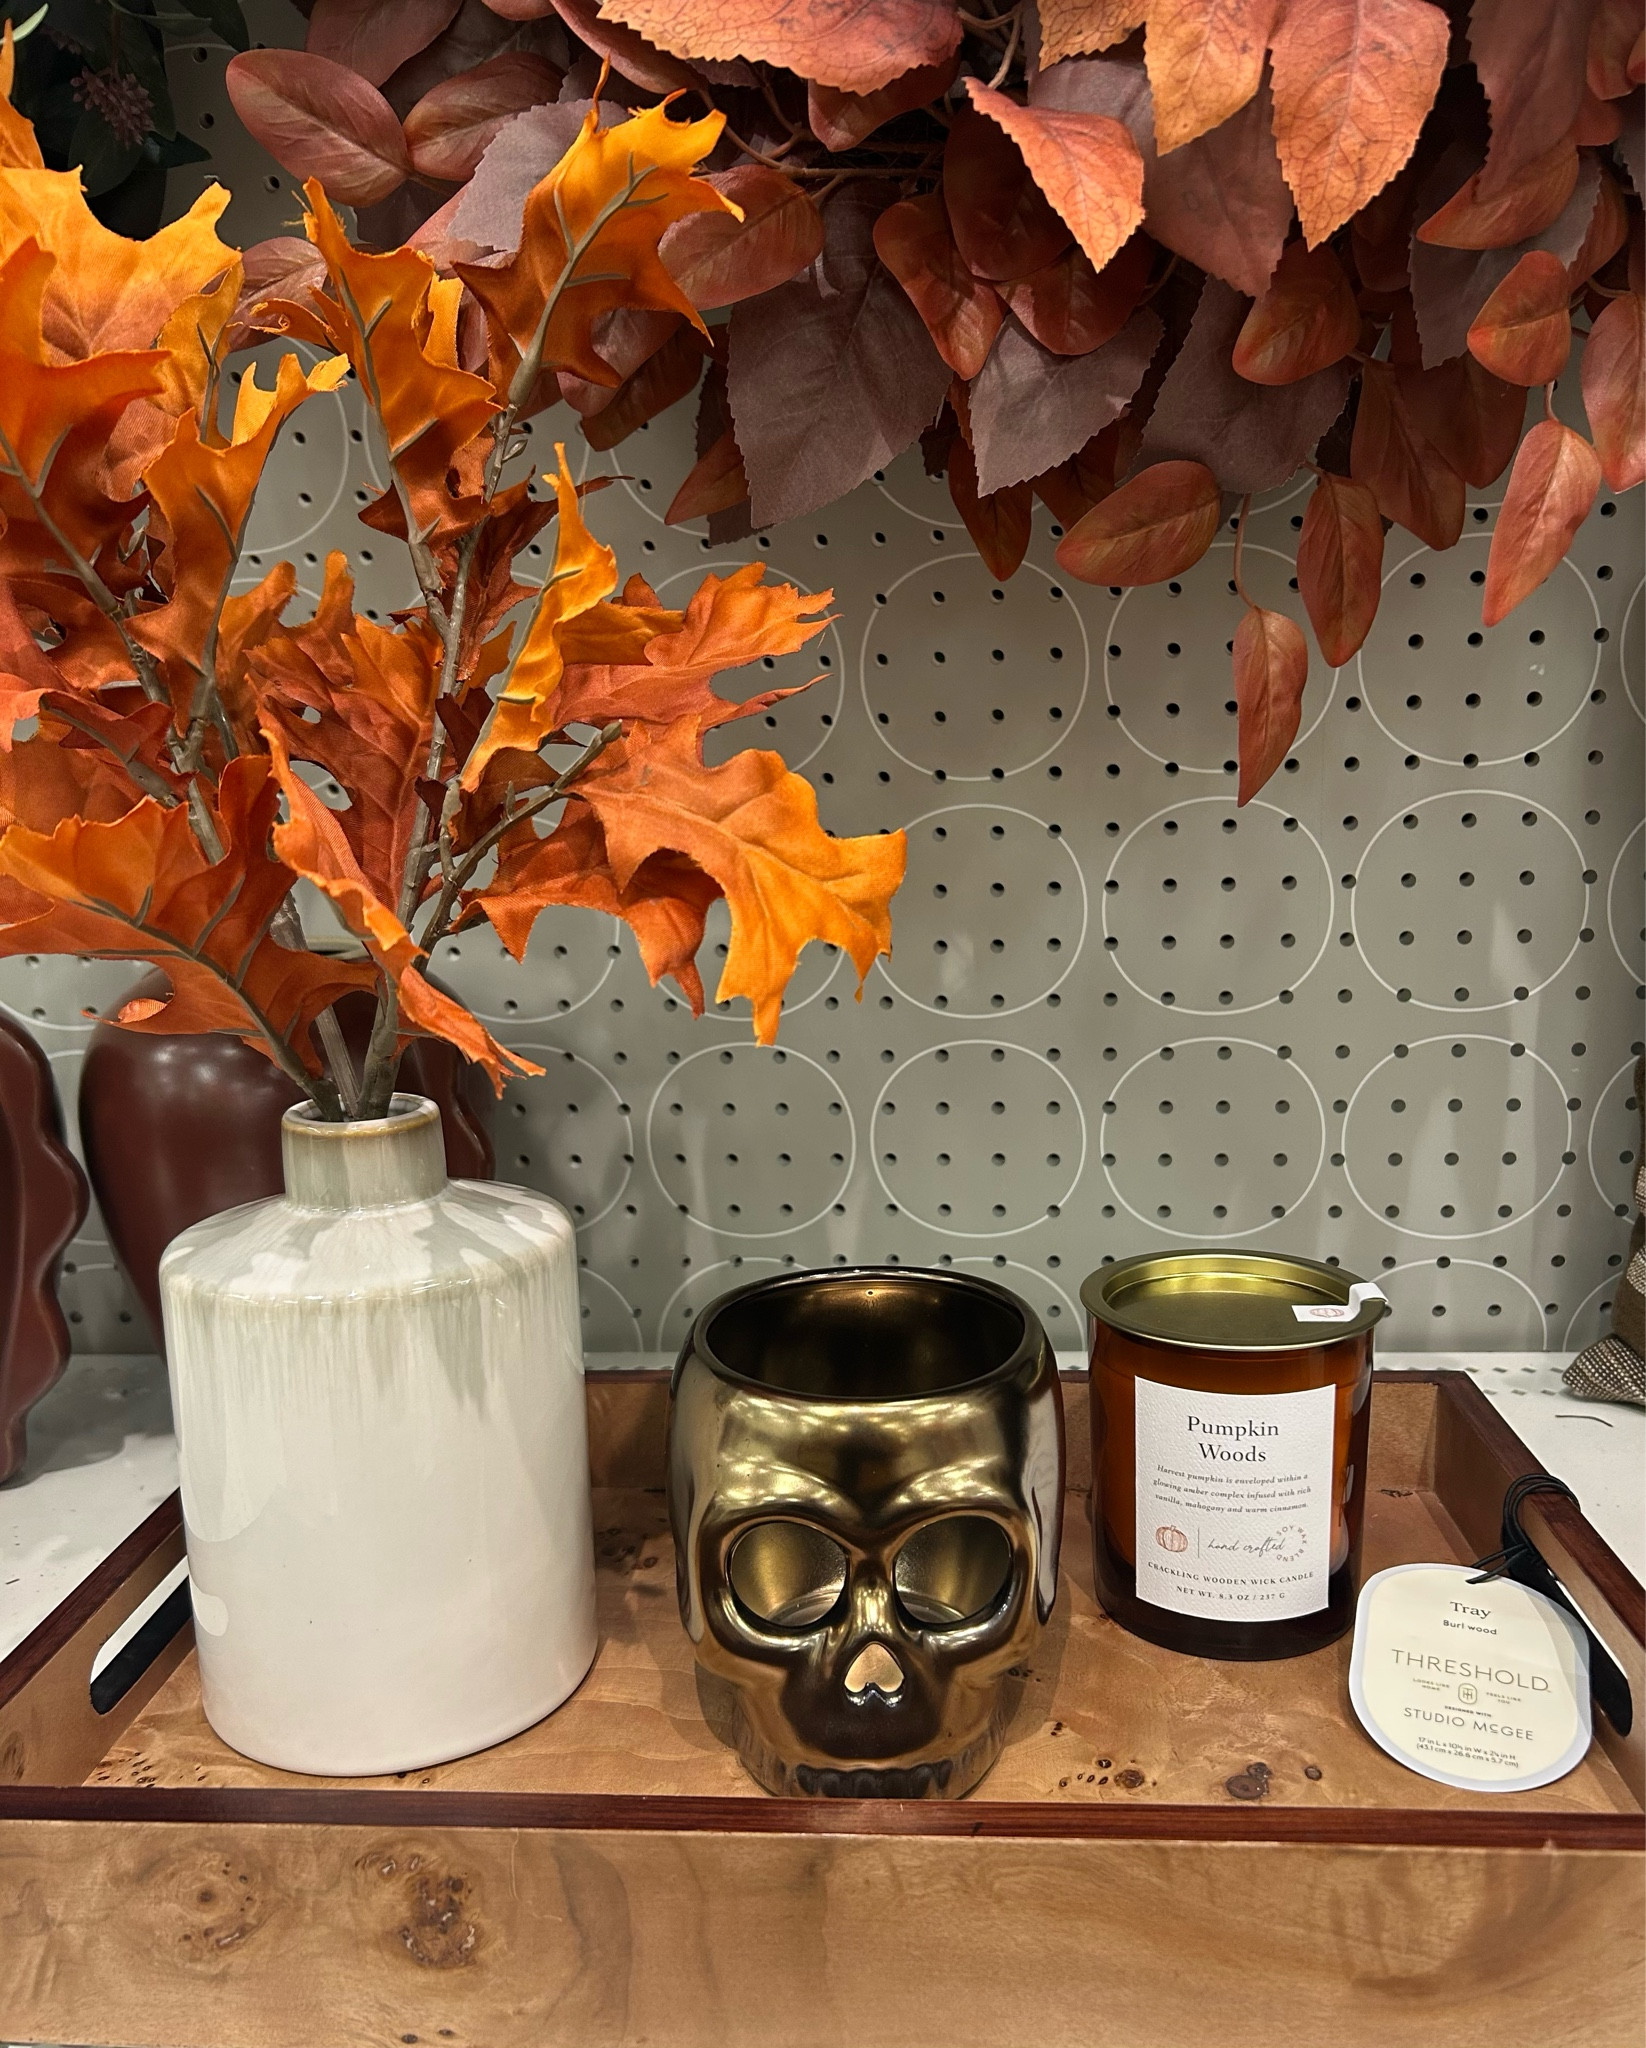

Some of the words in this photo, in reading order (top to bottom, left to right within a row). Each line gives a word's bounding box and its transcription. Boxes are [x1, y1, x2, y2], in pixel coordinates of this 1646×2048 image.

[1187, 1415, 1279, 1441] Pumpkin
[1198, 1442, 1266, 1462] Woods
[1157, 1464, 1185, 1478] Harvest
[1187, 1472, 1223, 1484] pumpkin
[1226, 1476, 1233, 1484] is
[1235, 1476, 1275, 1486] enveloped
[1277, 1472, 1302, 1483] within
[1153, 1478, 1182, 1493] glowing
[1183, 1485, 1208, 1496] amber
[1210, 1490, 1245, 1499] complex
[1247, 1489, 1276, 1500] infused
[1278, 1488, 1295, 1497] with
[1297, 1486, 1312, 1495] rich
[1155, 1493, 1183, 1506] vanilla,
[1185, 1500, 1225, 1513] mahogany
[1227, 1505, 1243, 1513] and
[1269, 1502, 1309, 1513] cinnamon.
[1208, 1538, 1240, 1552] hand
[1243, 1536, 1285, 1557] crafted
[1148, 1561, 1199, 1581] CRACKLING
[1203, 1575, 1247, 1585] WOODEN
[1250, 1577, 1276, 1585] WICK
[1279, 1571, 1314, 1583] CANDLE
[1176, 1585, 1195, 1595] NET
[1198, 1590, 1215, 1598] WT.
[1450, 1601, 1492, 1620] Tray
[1443, 1619, 1465, 1631] Burl
[1467, 1624, 1498, 1635] wood
[1391, 1649, 1549, 1692] THRESHOLD
[1404, 1707, 1465, 1727] STUDIO
[1504, 1760, 1519, 1768] cm)
